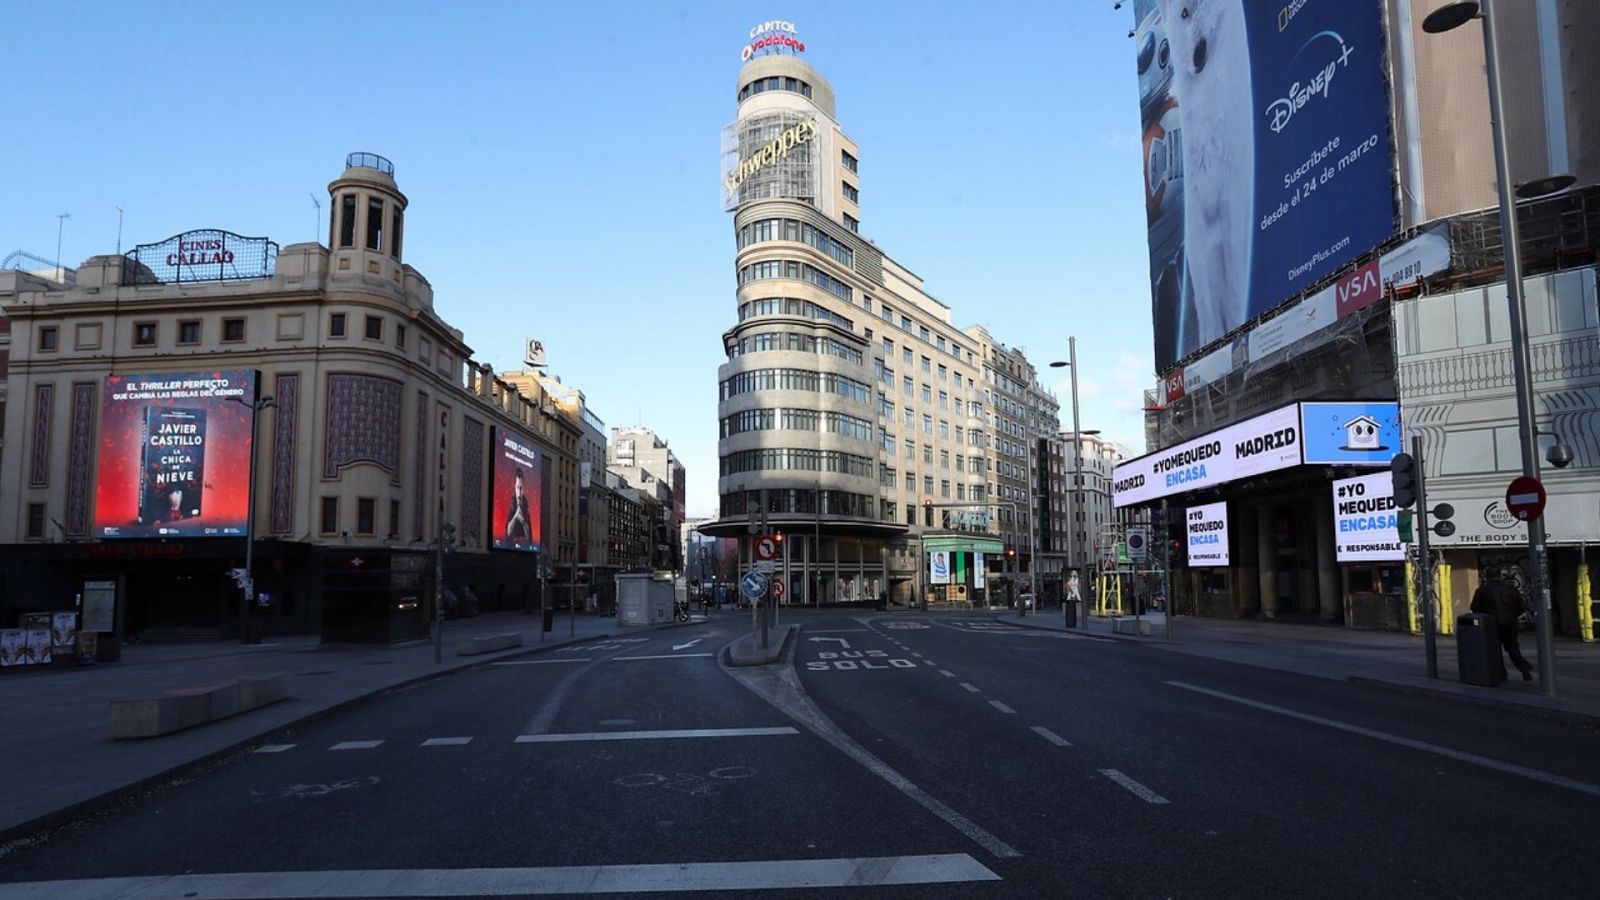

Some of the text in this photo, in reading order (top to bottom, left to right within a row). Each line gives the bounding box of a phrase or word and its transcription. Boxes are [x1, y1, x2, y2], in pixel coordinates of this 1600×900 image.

[750, 20, 798, 38] CAPITOL
[751, 34, 805, 52] vodafone
[724, 116, 816, 203] Schweppes
[1261, 134, 1378, 230] desde el 24 de marzo
[180, 240, 221, 251] CINES
[166, 250, 234, 266] CALLAO
[1287, 236, 1351, 281] DisneyPlus.com
[1339, 270, 1377, 303] VSA
[126, 379, 229, 391] EL THRILLER PERFECTO
[1166, 375, 1184, 393] VSA
[113, 391, 128, 400] QUE
[129, 390, 156, 400] CAMBIA
[157, 390, 171, 399] LAS
[171, 388, 199, 398] REGLAS
[158, 424, 197, 434] JAVIER
[150, 435, 202, 446] CASTILLO
[1235, 427, 1297, 460] MADRID
[161, 455, 192, 464] CHICA
[439, 411, 448, 514] CALLA
[1153, 441, 1222, 473] #YOMEQUEDO
[156, 471, 194, 484] NIEVE
[1166, 464, 1207, 487] ENCASA
[1114, 474, 1145, 494] MADRID
[1338, 483, 1365, 498] #YO
[1339, 496, 1397, 516] MEQUED
[1189, 510, 1203, 521] #YO
[1339, 514, 1398, 532] ENCASA
[1189, 520, 1224, 533] MEQUEDO
[1190, 534, 1219, 545] ENCASA
[1459, 533, 1551, 543] THE BODY SP
[1346, 543, 1402, 552] RESPONSABLE
[819, 650, 889, 659] BUS
[805, 659, 917, 671] SOLO
